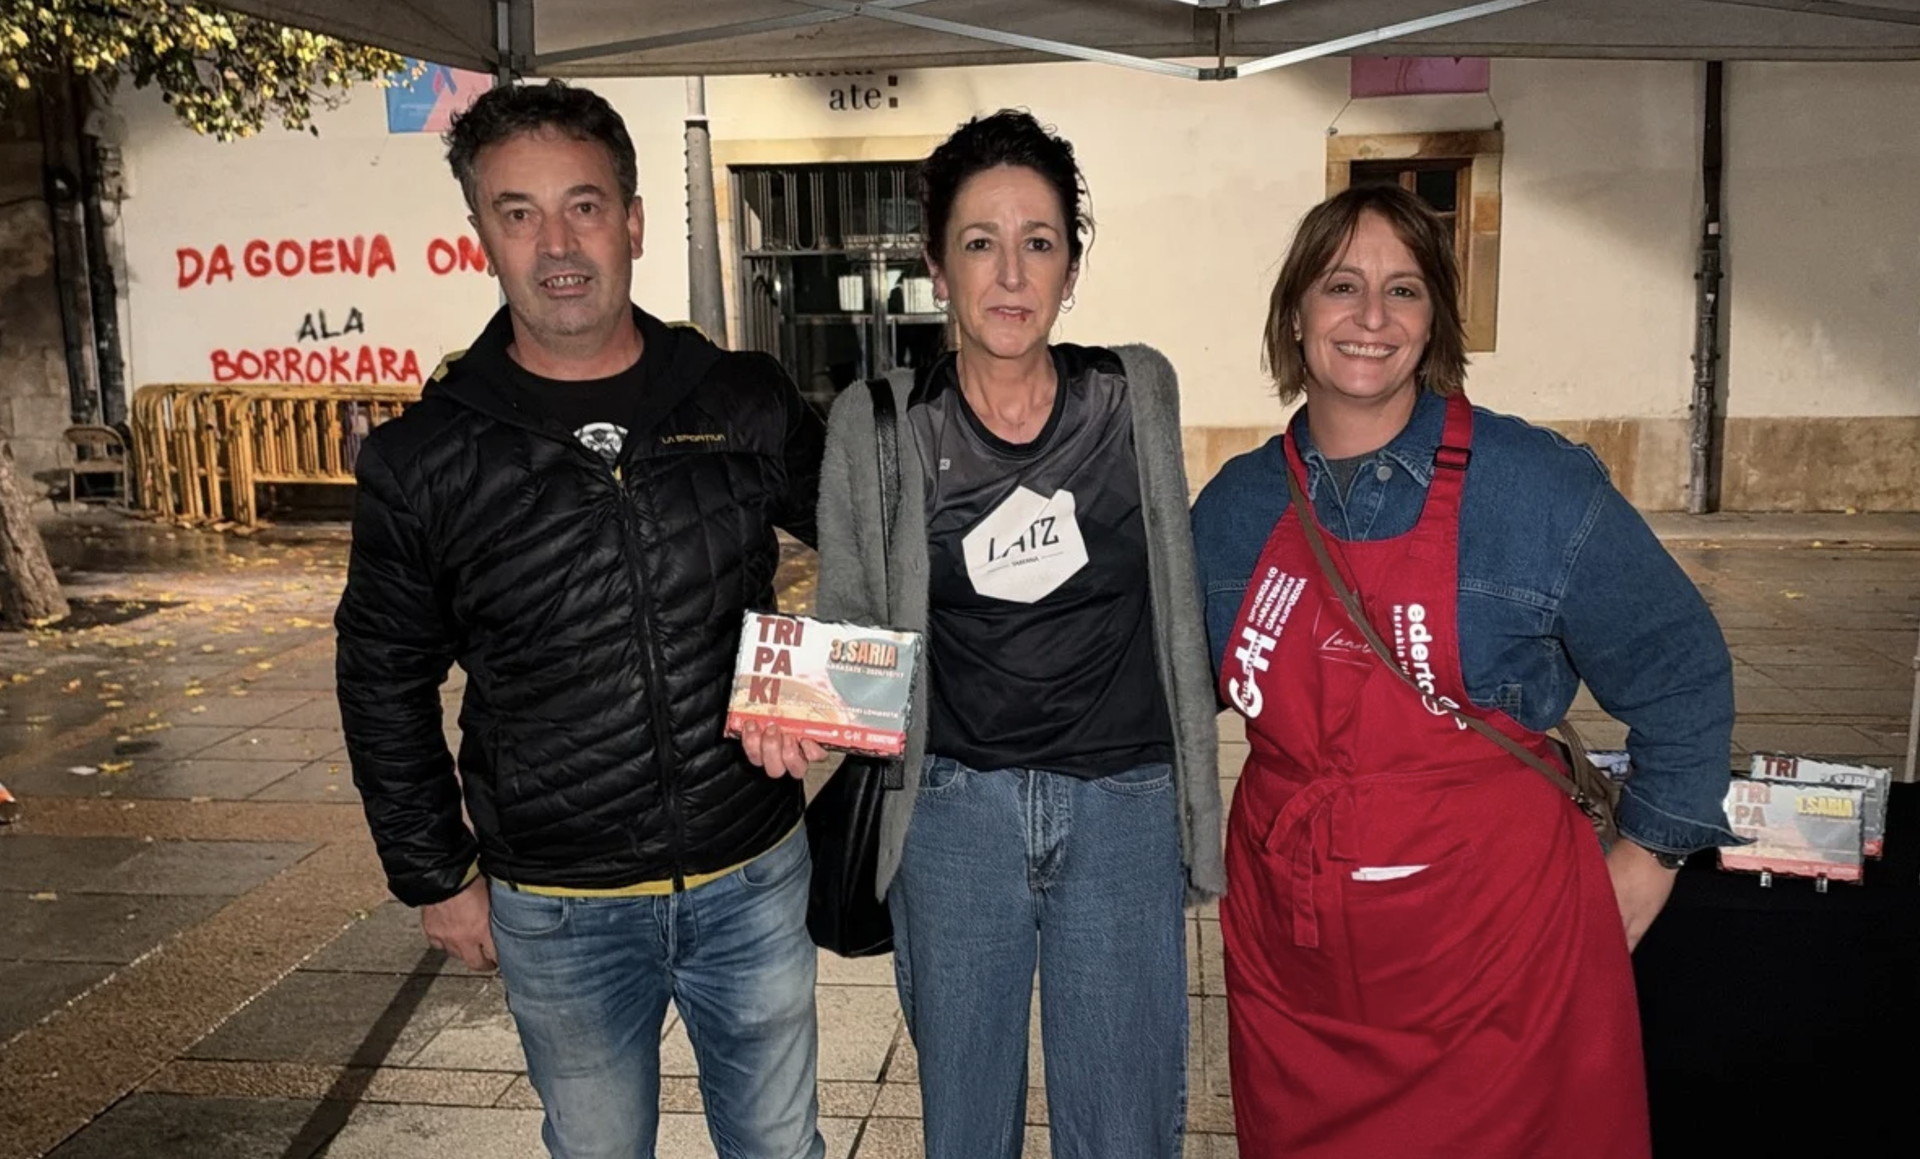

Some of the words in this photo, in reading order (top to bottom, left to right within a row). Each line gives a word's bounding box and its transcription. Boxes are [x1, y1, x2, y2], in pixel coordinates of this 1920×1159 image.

[297, 306, 365, 343] ALA
[210, 344, 424, 384] BORROKARA
[756, 616, 805, 647] TRI
[1273, 625, 1284, 637] DE
[753, 646, 792, 676] PA
[830, 638, 899, 670] 3.SARIA
[748, 677, 782, 705] KI
[1763, 756, 1799, 779] TRI
[1733, 783, 1771, 805] TRI
[1735, 805, 1766, 828] PA
